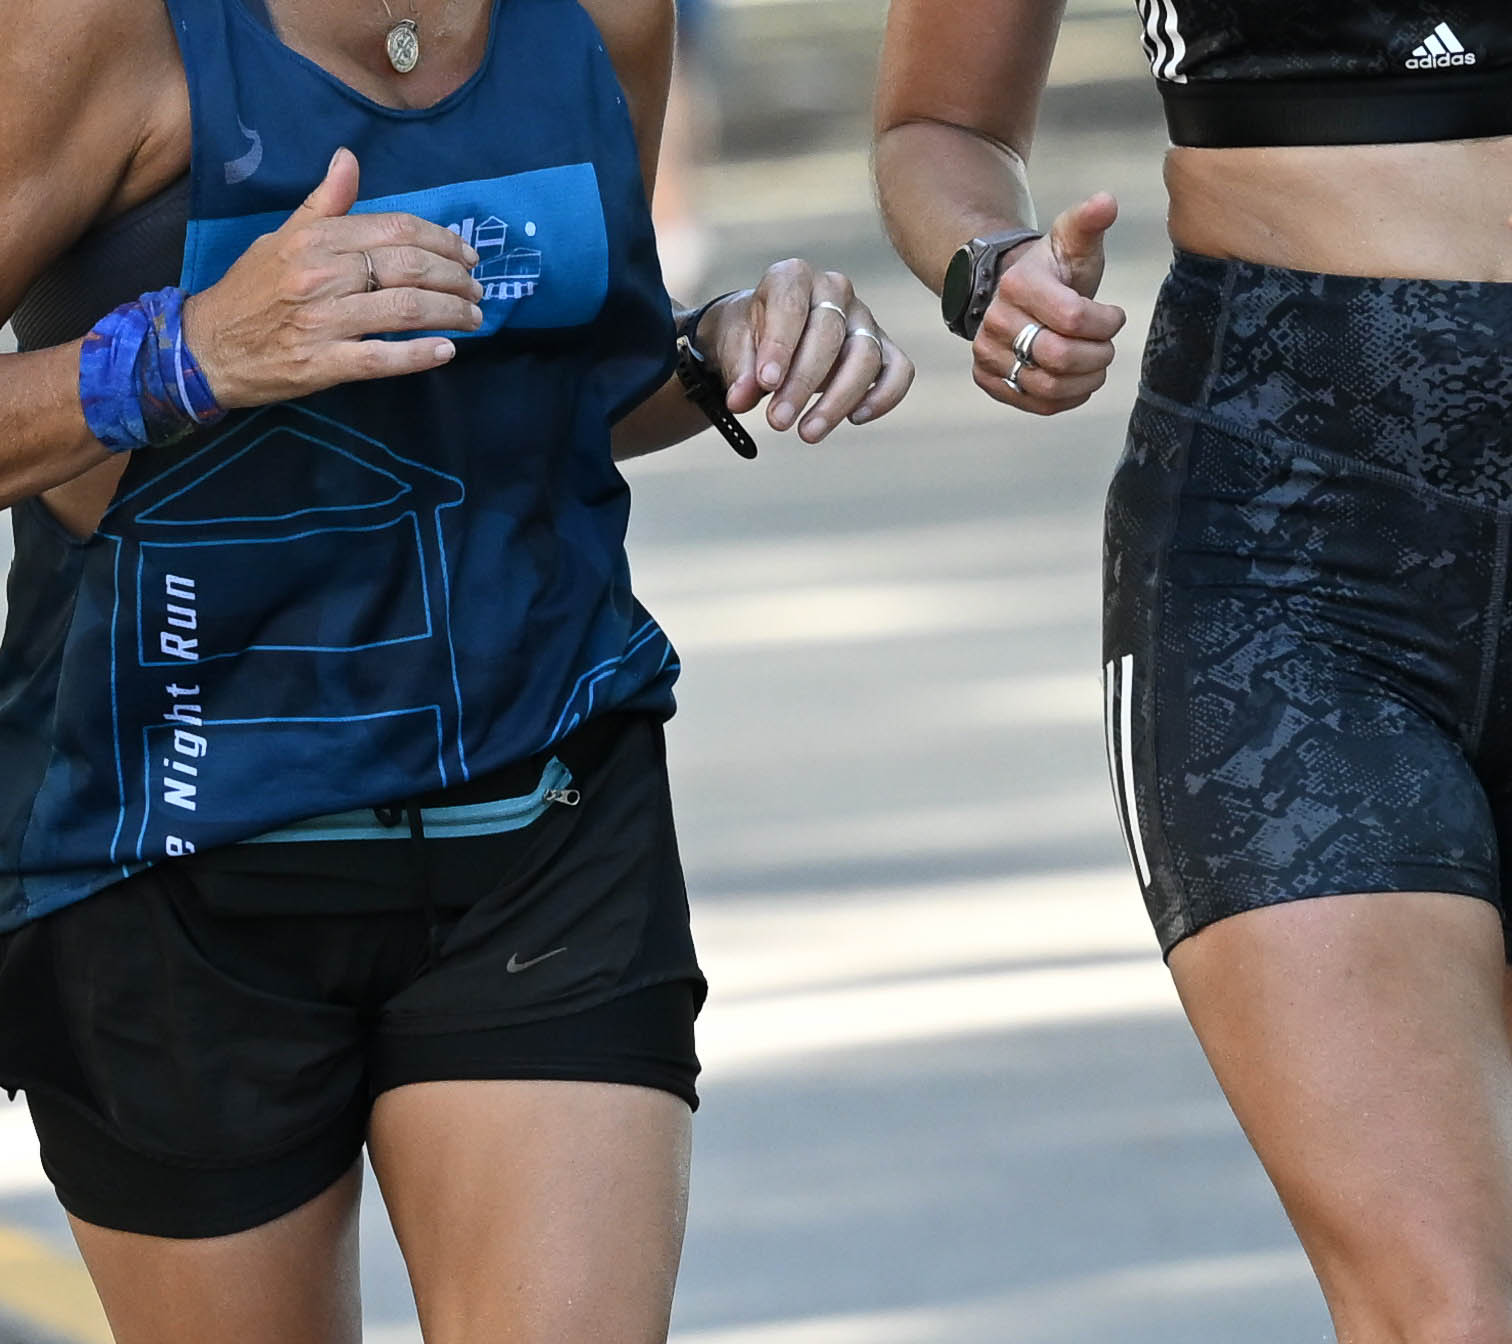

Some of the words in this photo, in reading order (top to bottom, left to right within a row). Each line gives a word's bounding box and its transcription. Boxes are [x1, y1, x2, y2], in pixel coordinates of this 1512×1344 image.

[1405, 52, 1476, 70] adidas
[161, 574, 199, 660] Run
[163, 683, 208, 811] Night
